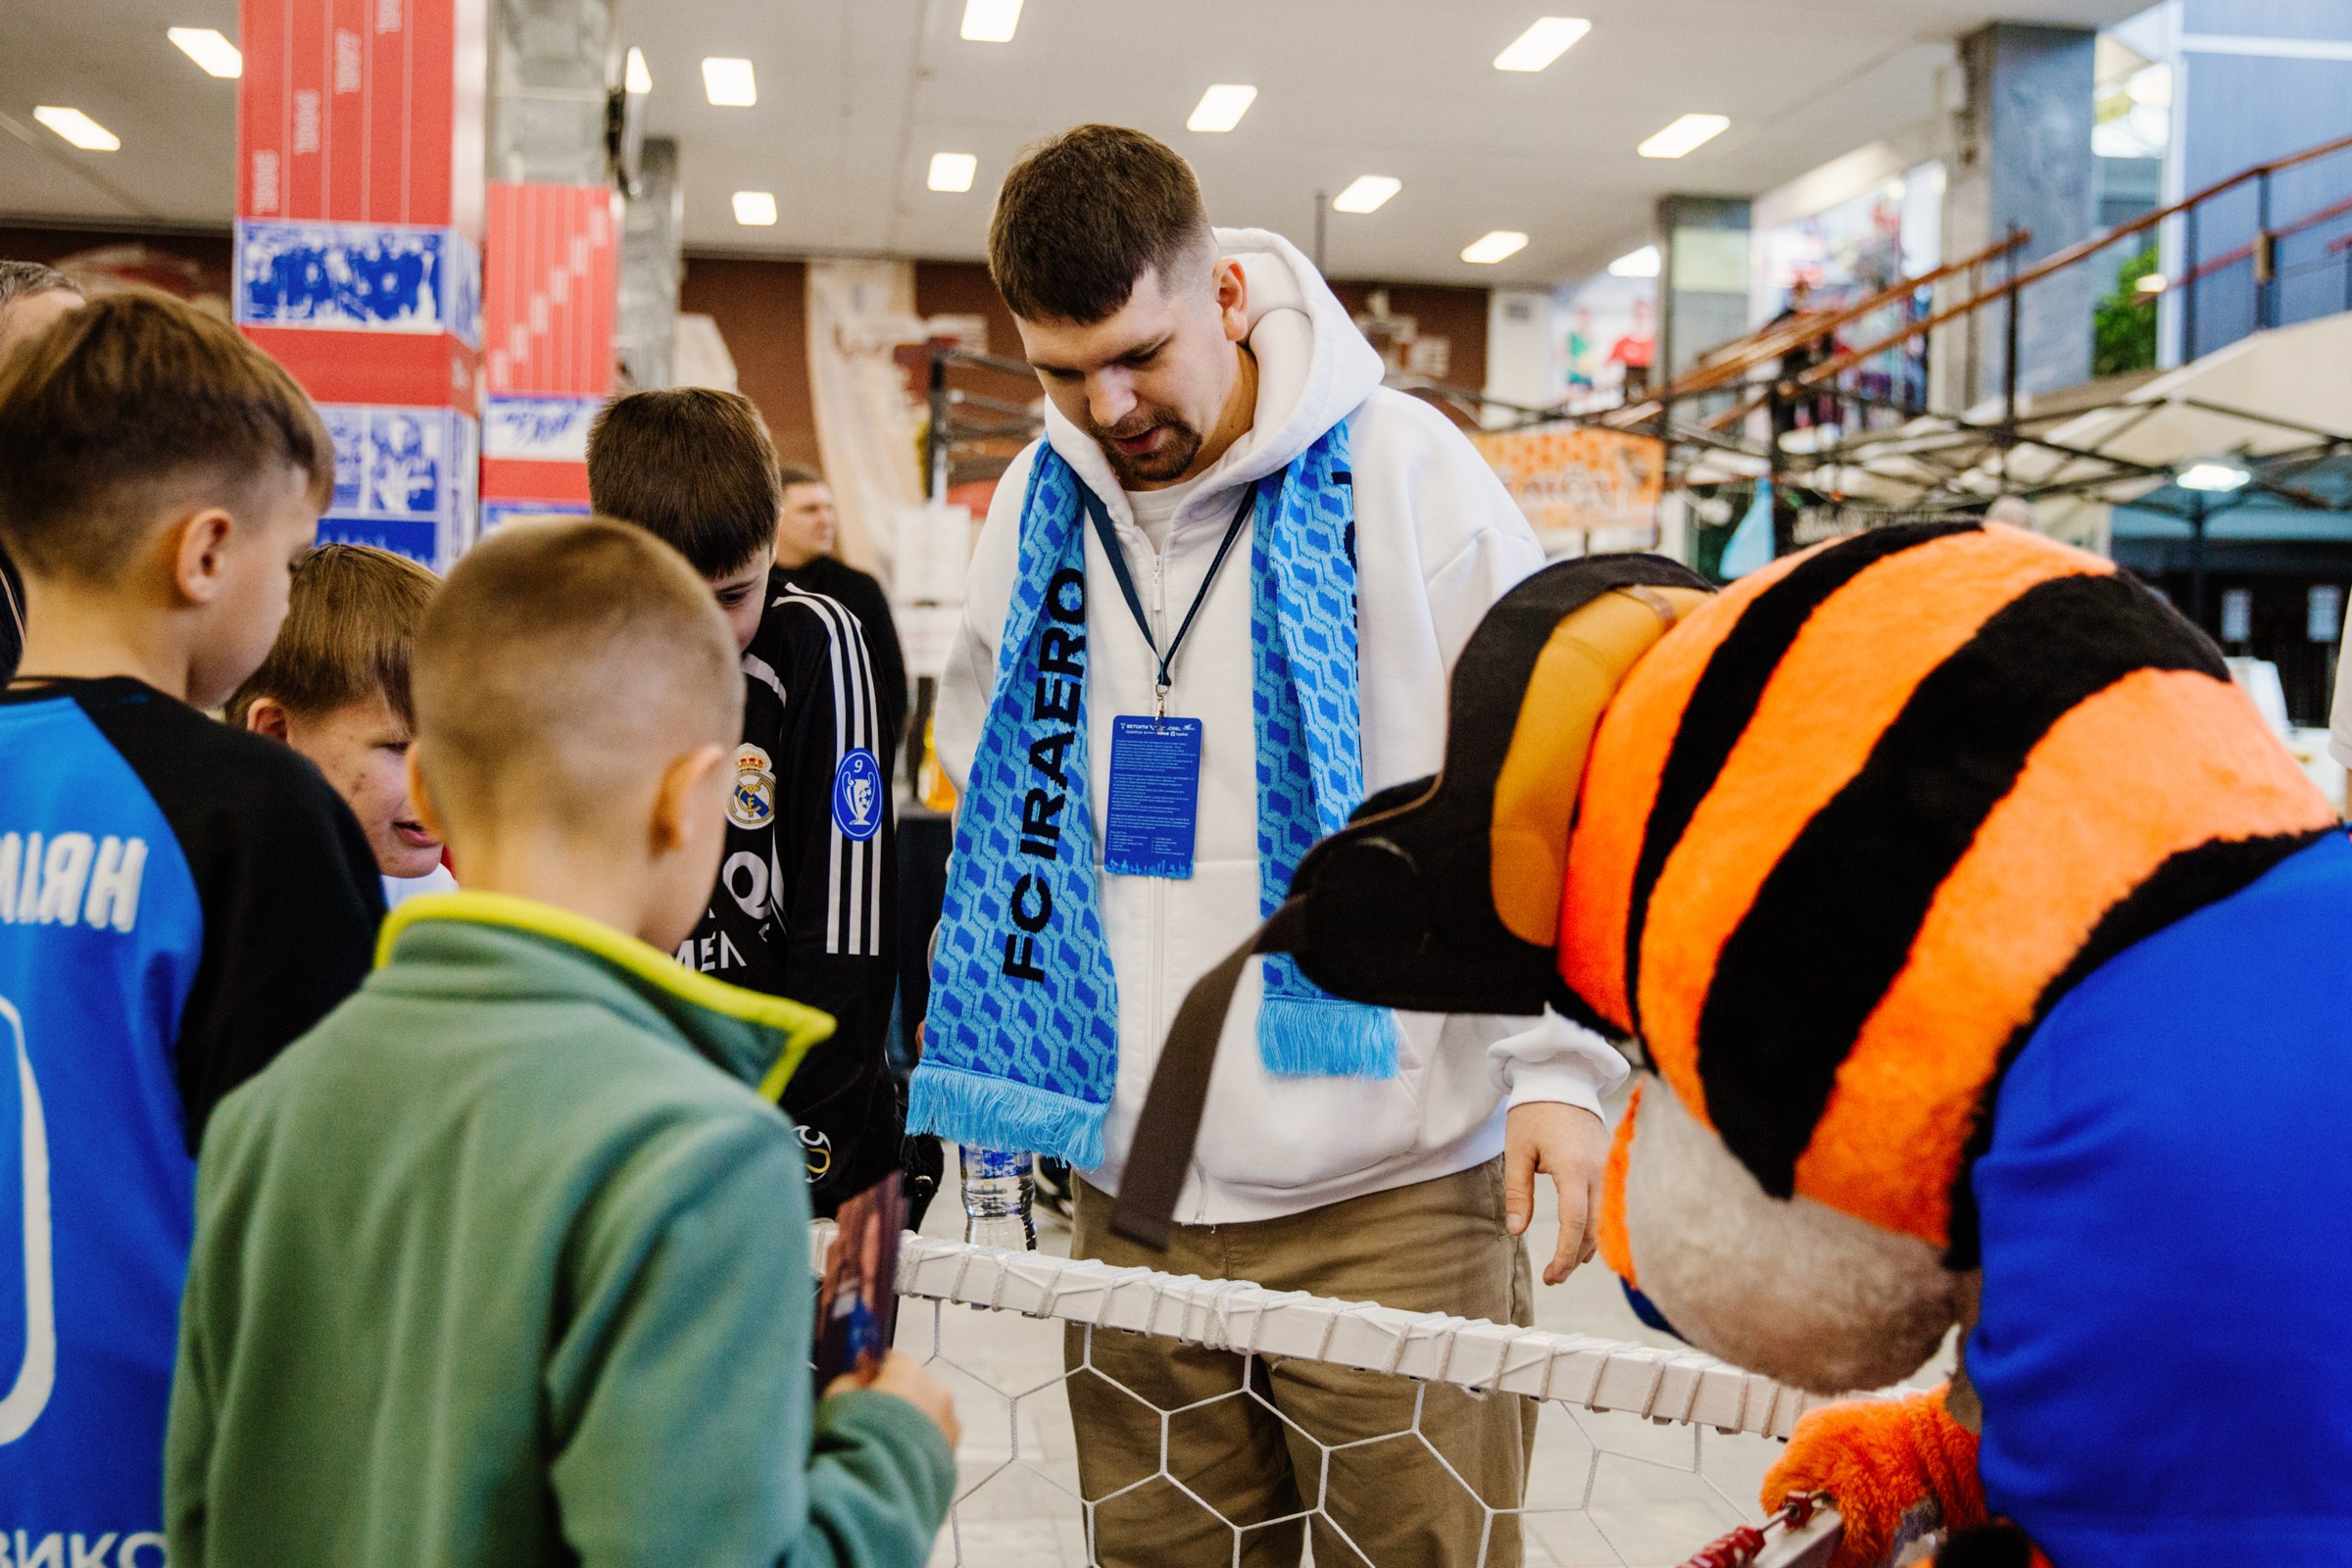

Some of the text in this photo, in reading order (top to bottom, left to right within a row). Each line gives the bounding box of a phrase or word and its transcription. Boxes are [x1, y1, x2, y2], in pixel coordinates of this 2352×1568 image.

[854, 759, 863, 773] 9
[1002, 567, 1086, 984] FC IRAERO
[721, 851, 771, 920] Q
